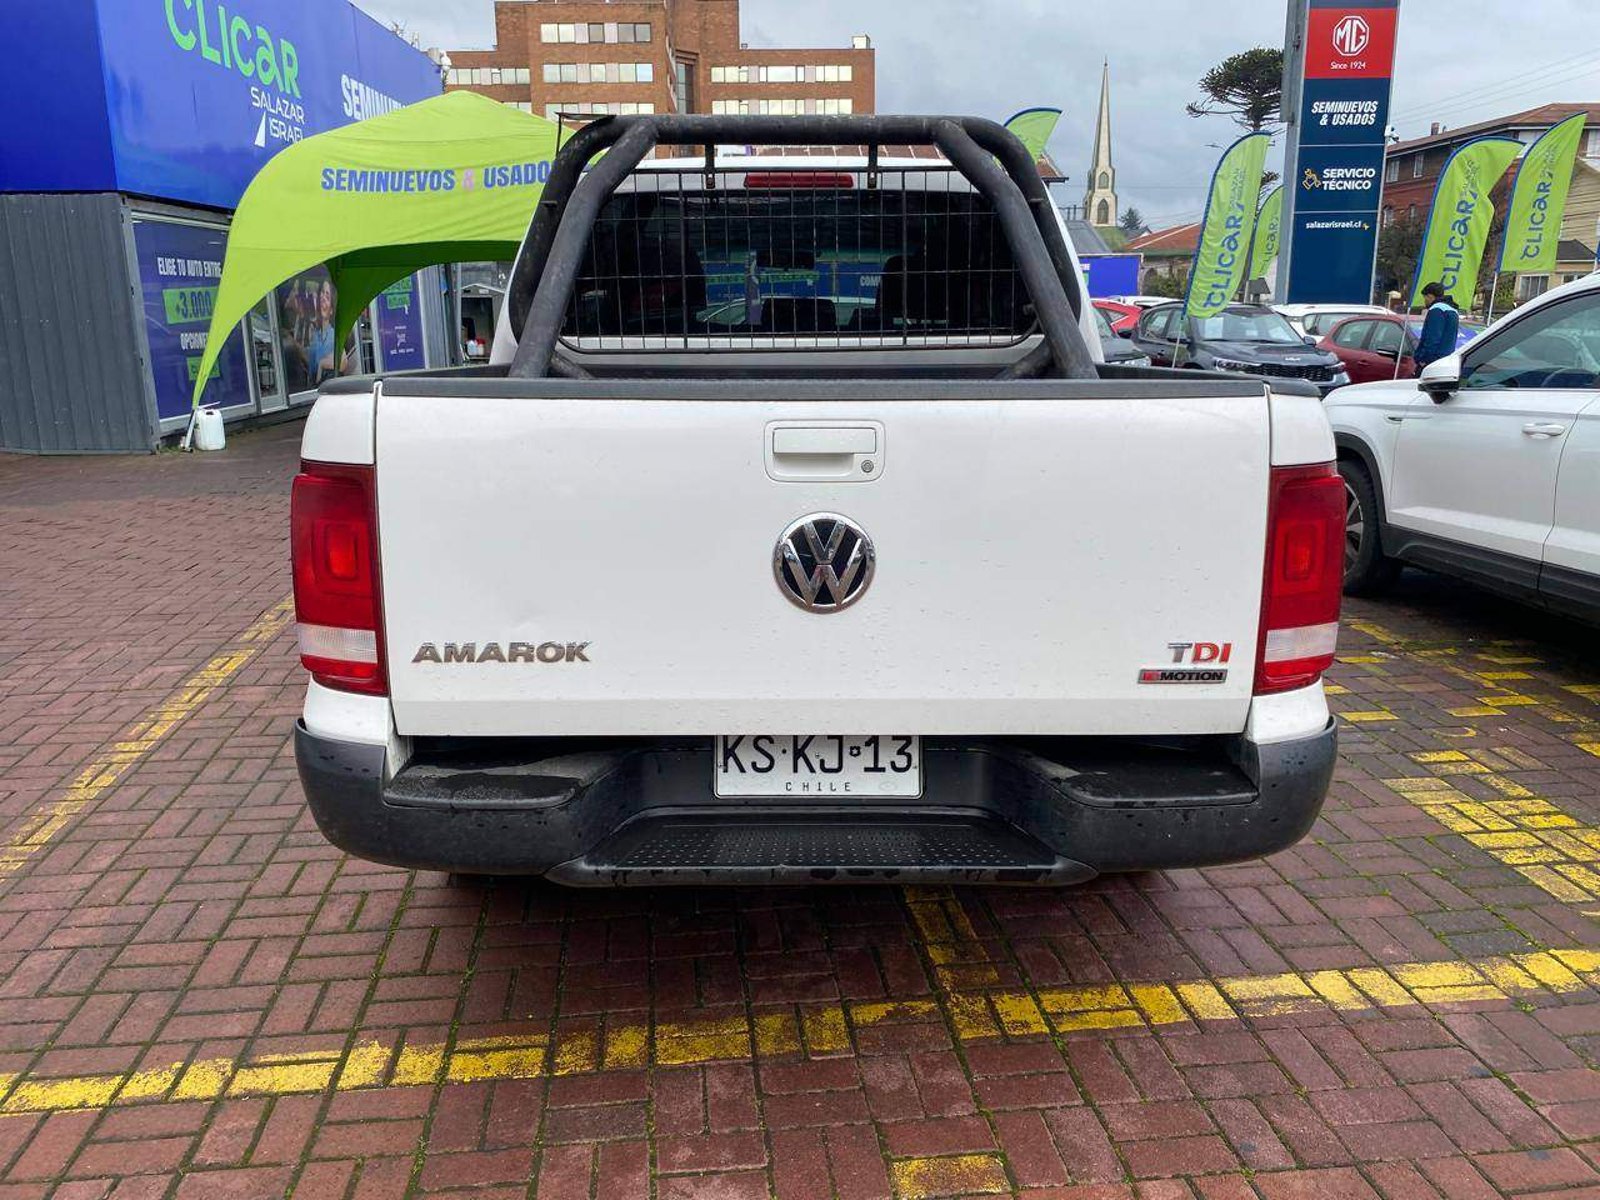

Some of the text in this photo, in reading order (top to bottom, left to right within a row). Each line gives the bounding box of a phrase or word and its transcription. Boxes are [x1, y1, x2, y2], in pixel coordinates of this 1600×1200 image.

[1330, 61, 1367, 70] Since 1924
[250, 86, 305, 125] SALAZAR
[1311, 101, 1379, 114] SEMINUEVOS
[1319, 114, 1376, 126] & USADOS
[321, 167, 456, 193] SEMINUEVOS
[461, 168, 475, 191] &
[1322, 168, 1376, 179] SERVICIO
[1322, 177, 1372, 191] TÉCNICO
[1305, 219, 1362, 229] salazarisrael.cl
[157, 257, 177, 276] ELIGE
[177, 258, 187, 276] TU
[187, 259, 202, 277] AUTO
[411, 641, 592, 663] AMAROK
[1168, 642, 1233, 664] TDI
[785, 782, 852, 792] CHILE
